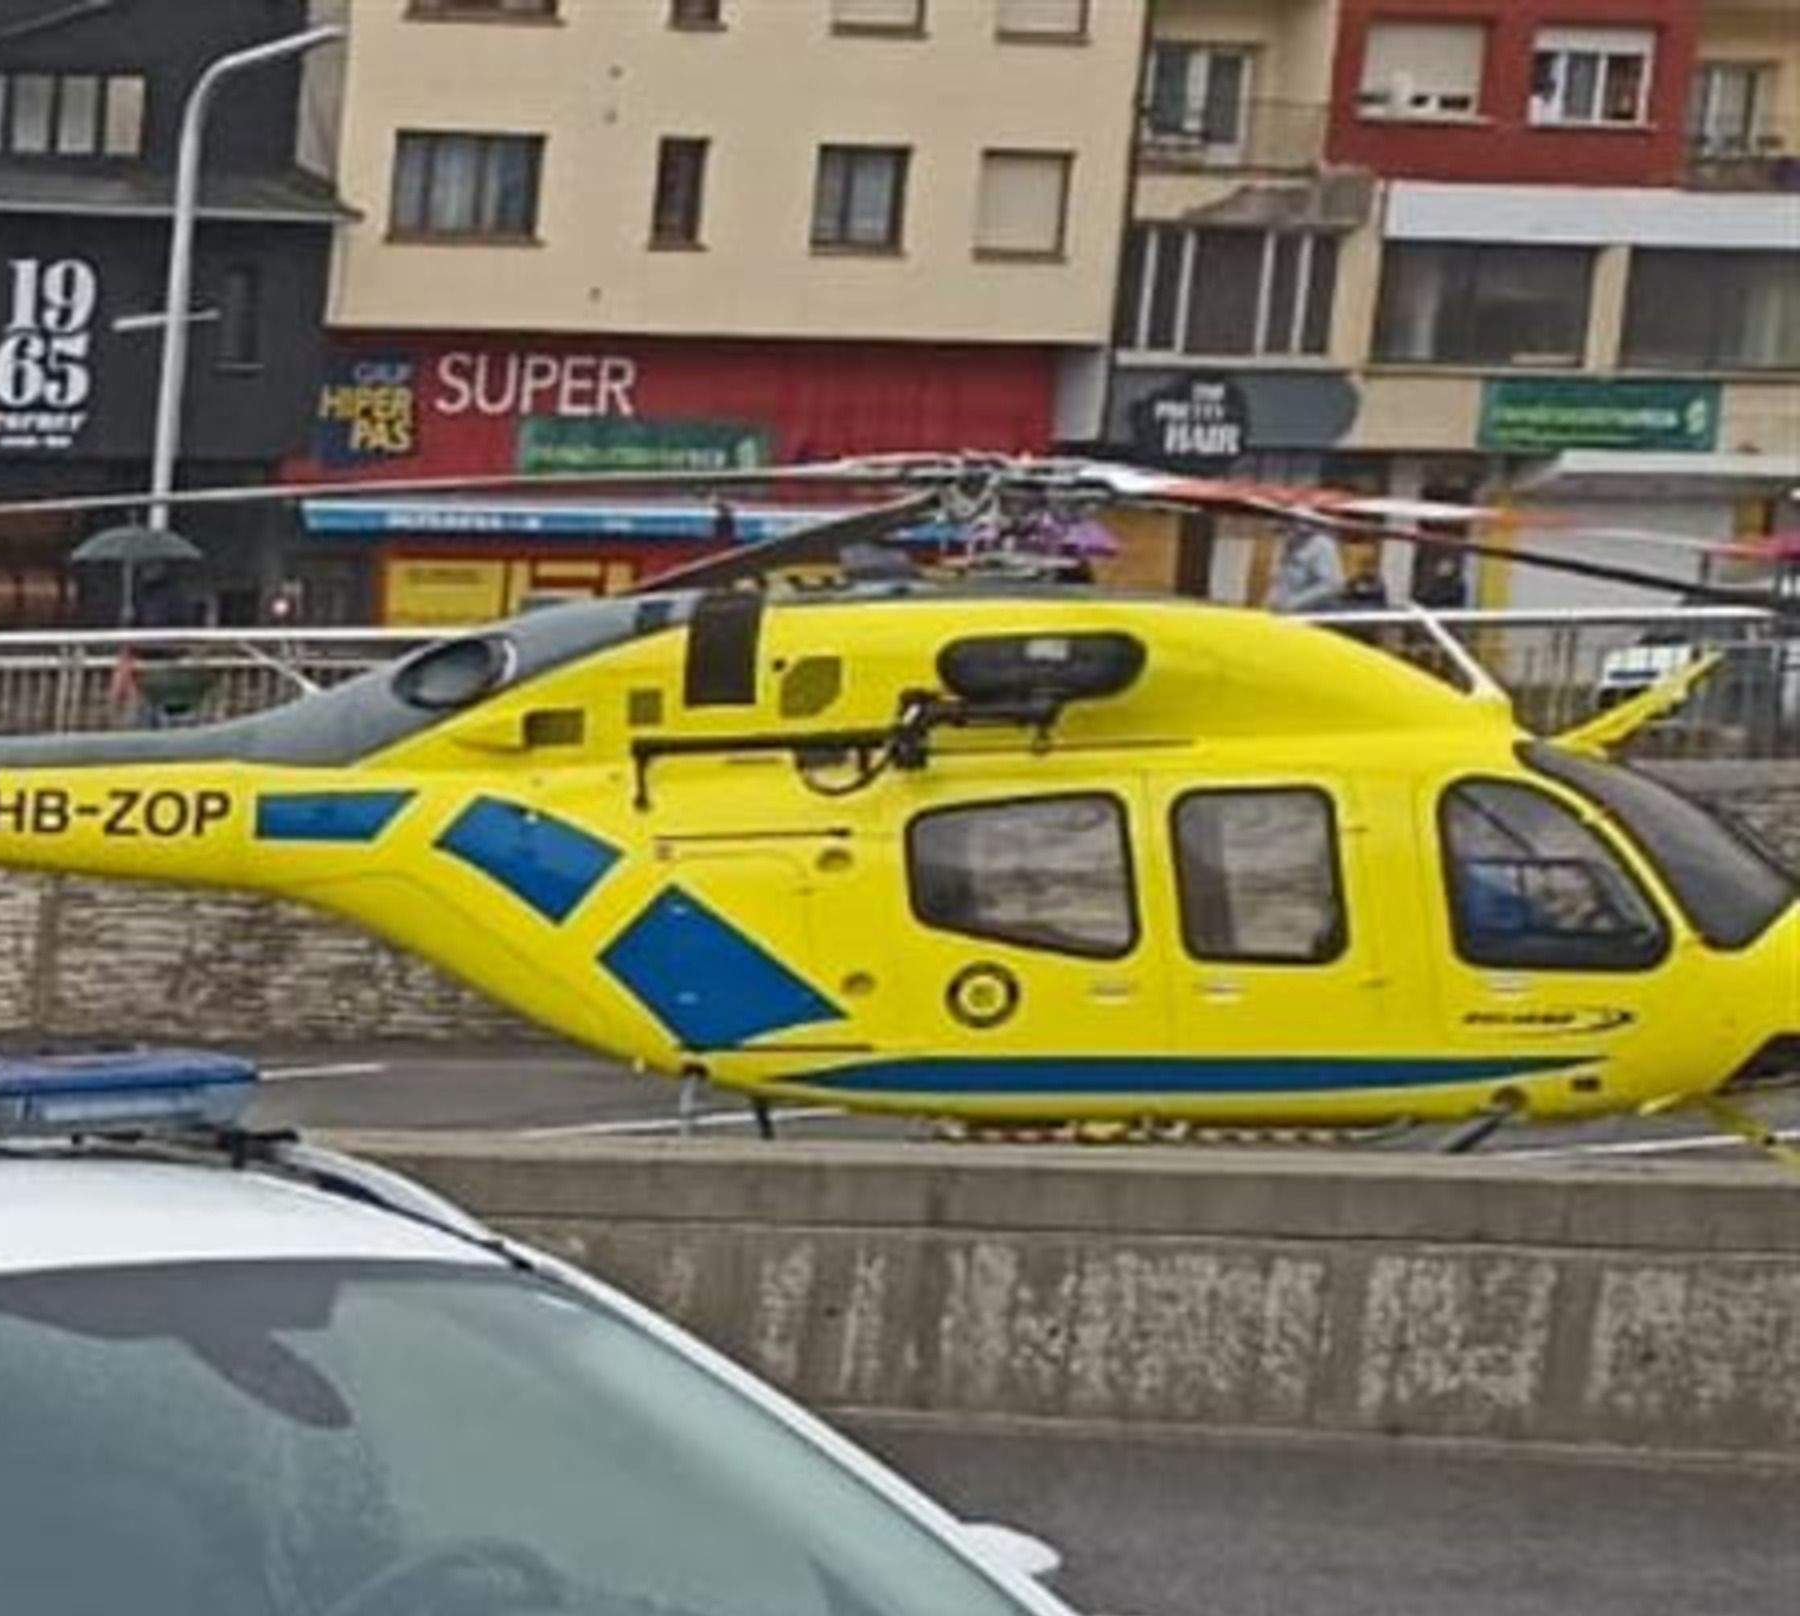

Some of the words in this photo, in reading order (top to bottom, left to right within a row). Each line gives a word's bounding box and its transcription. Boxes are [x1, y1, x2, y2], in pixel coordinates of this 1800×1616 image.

[6, 258, 96, 330] 19
[319, 386, 411, 419] HIPER
[436, 354, 636, 416] SUPER
[350, 420, 411, 452] PAS
